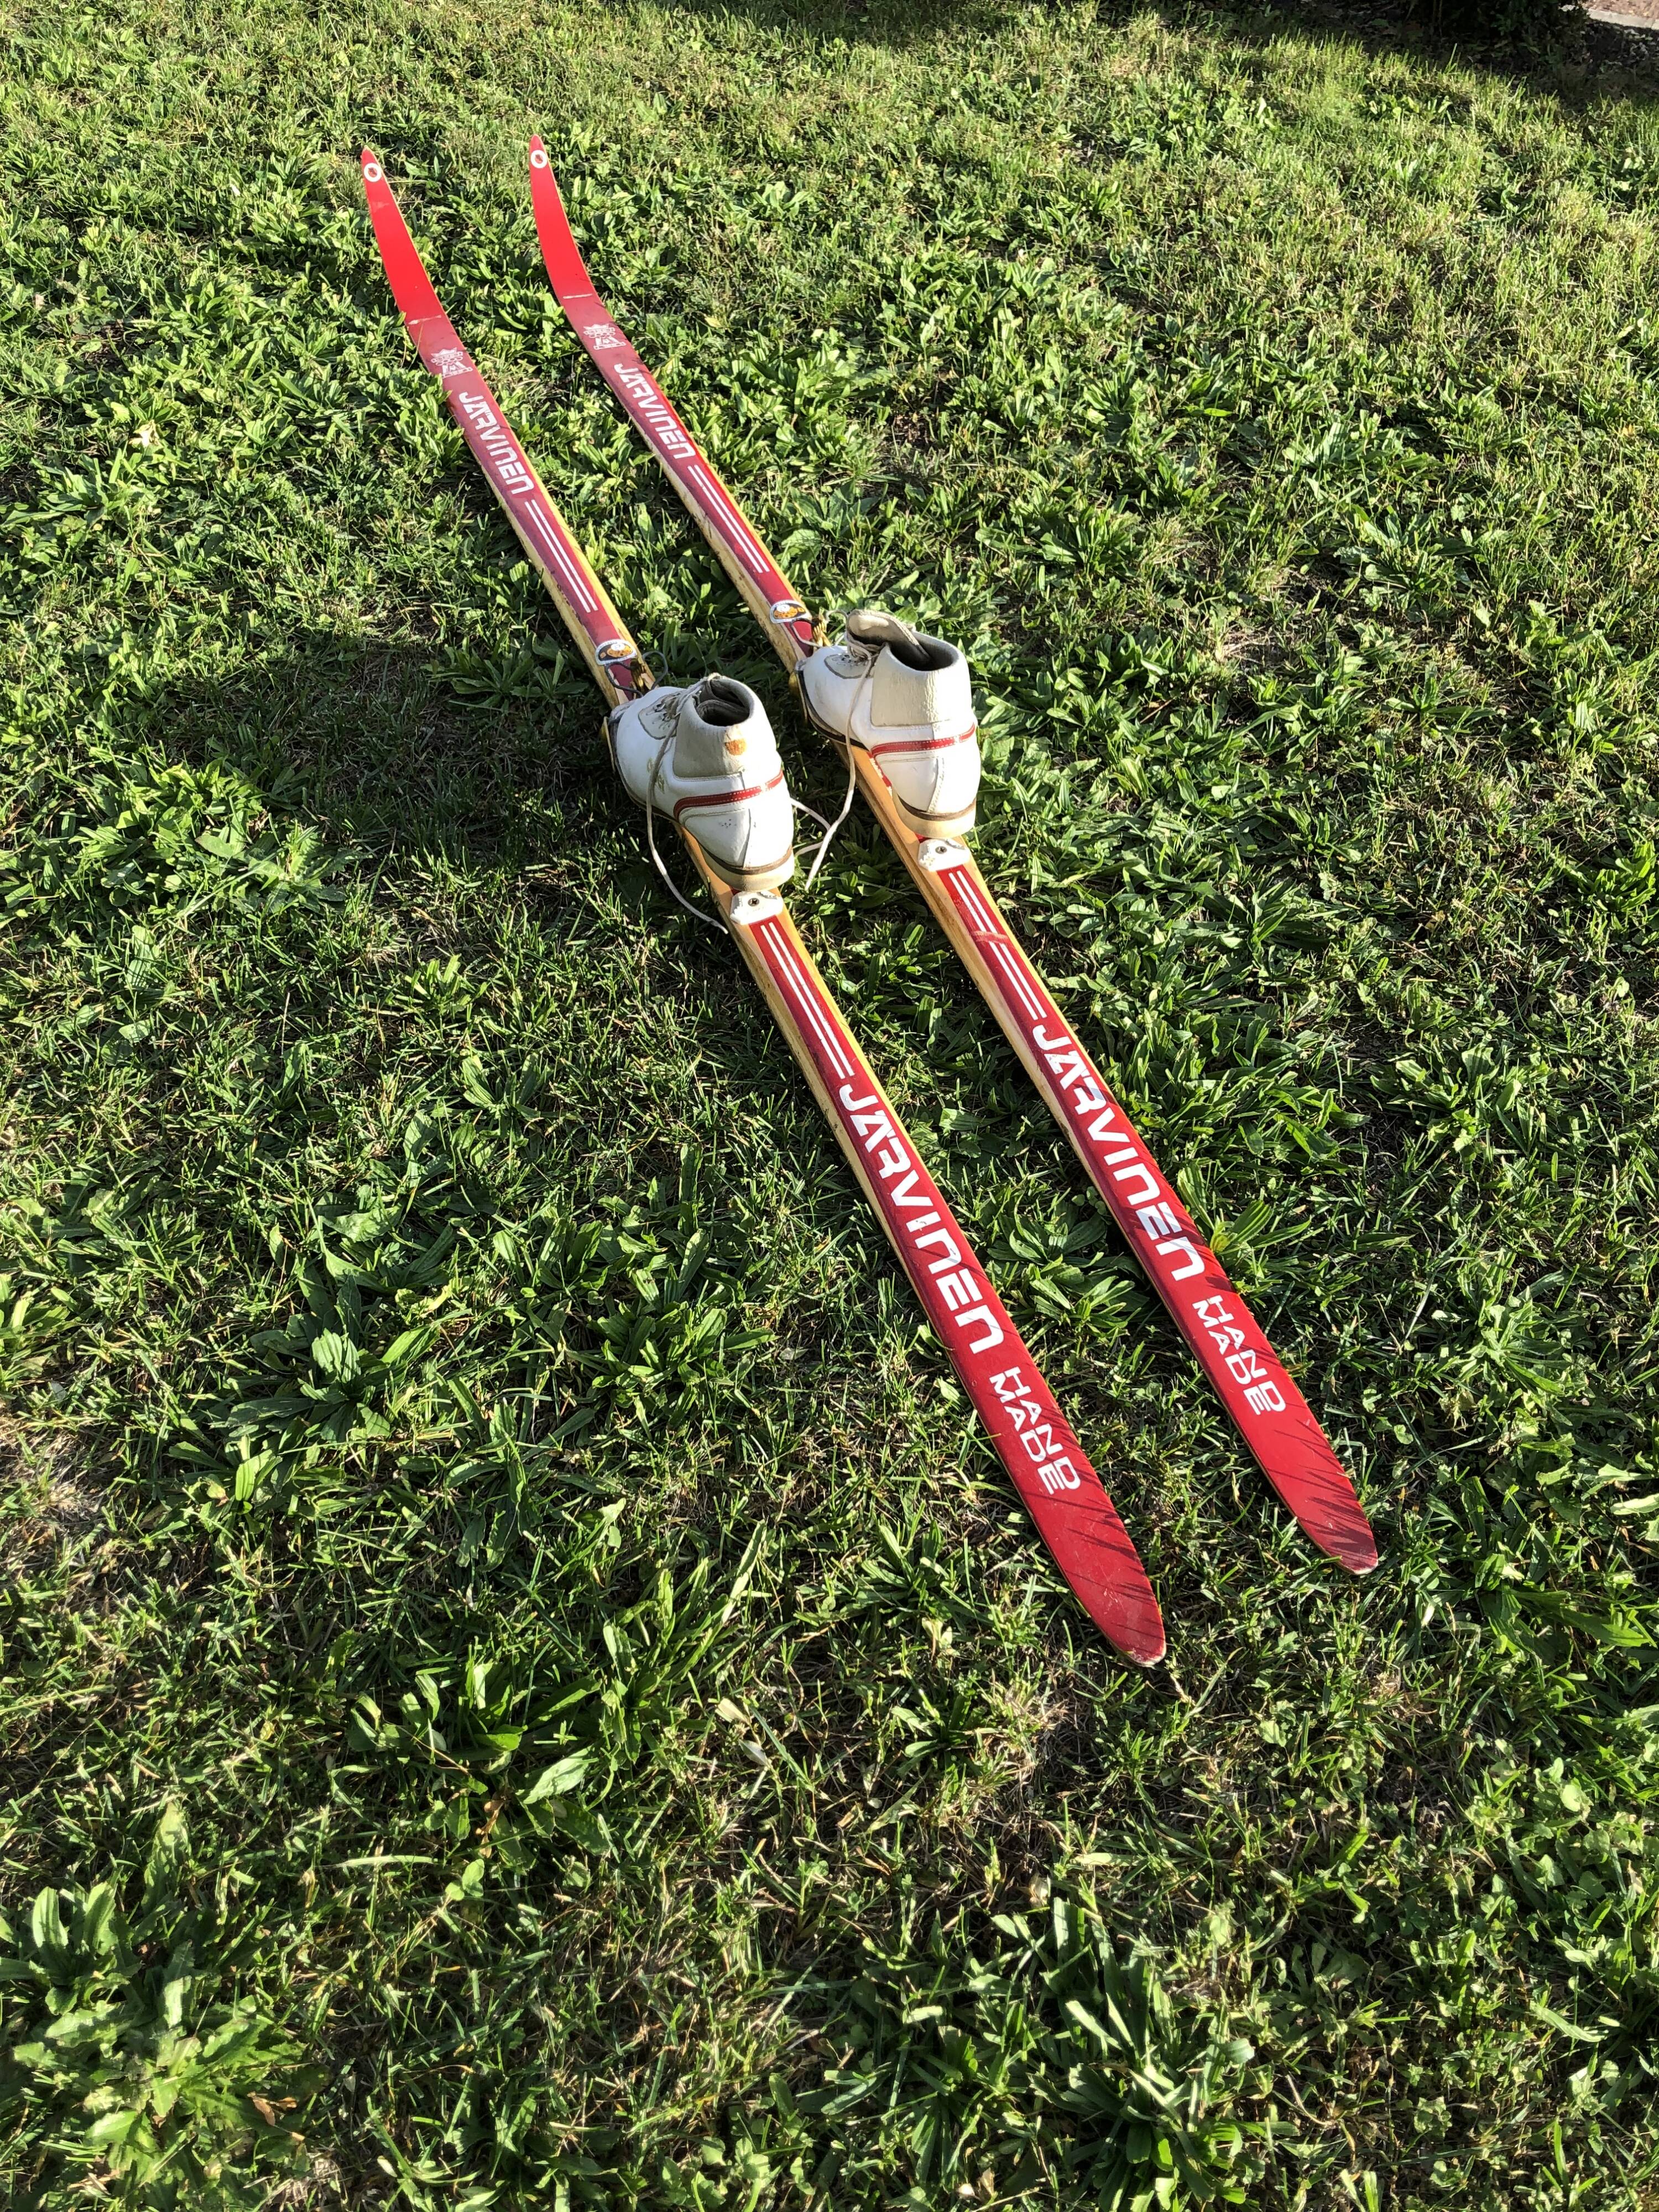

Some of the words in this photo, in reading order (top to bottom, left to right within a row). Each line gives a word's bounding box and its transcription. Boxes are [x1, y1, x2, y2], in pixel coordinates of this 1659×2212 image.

[1192, 1300, 1261, 1416] MADE
[1207, 1295, 1287, 1412] HAND
[989, 1372, 1066, 1495] MADE
[1004, 1366, 1081, 1490] HAND
